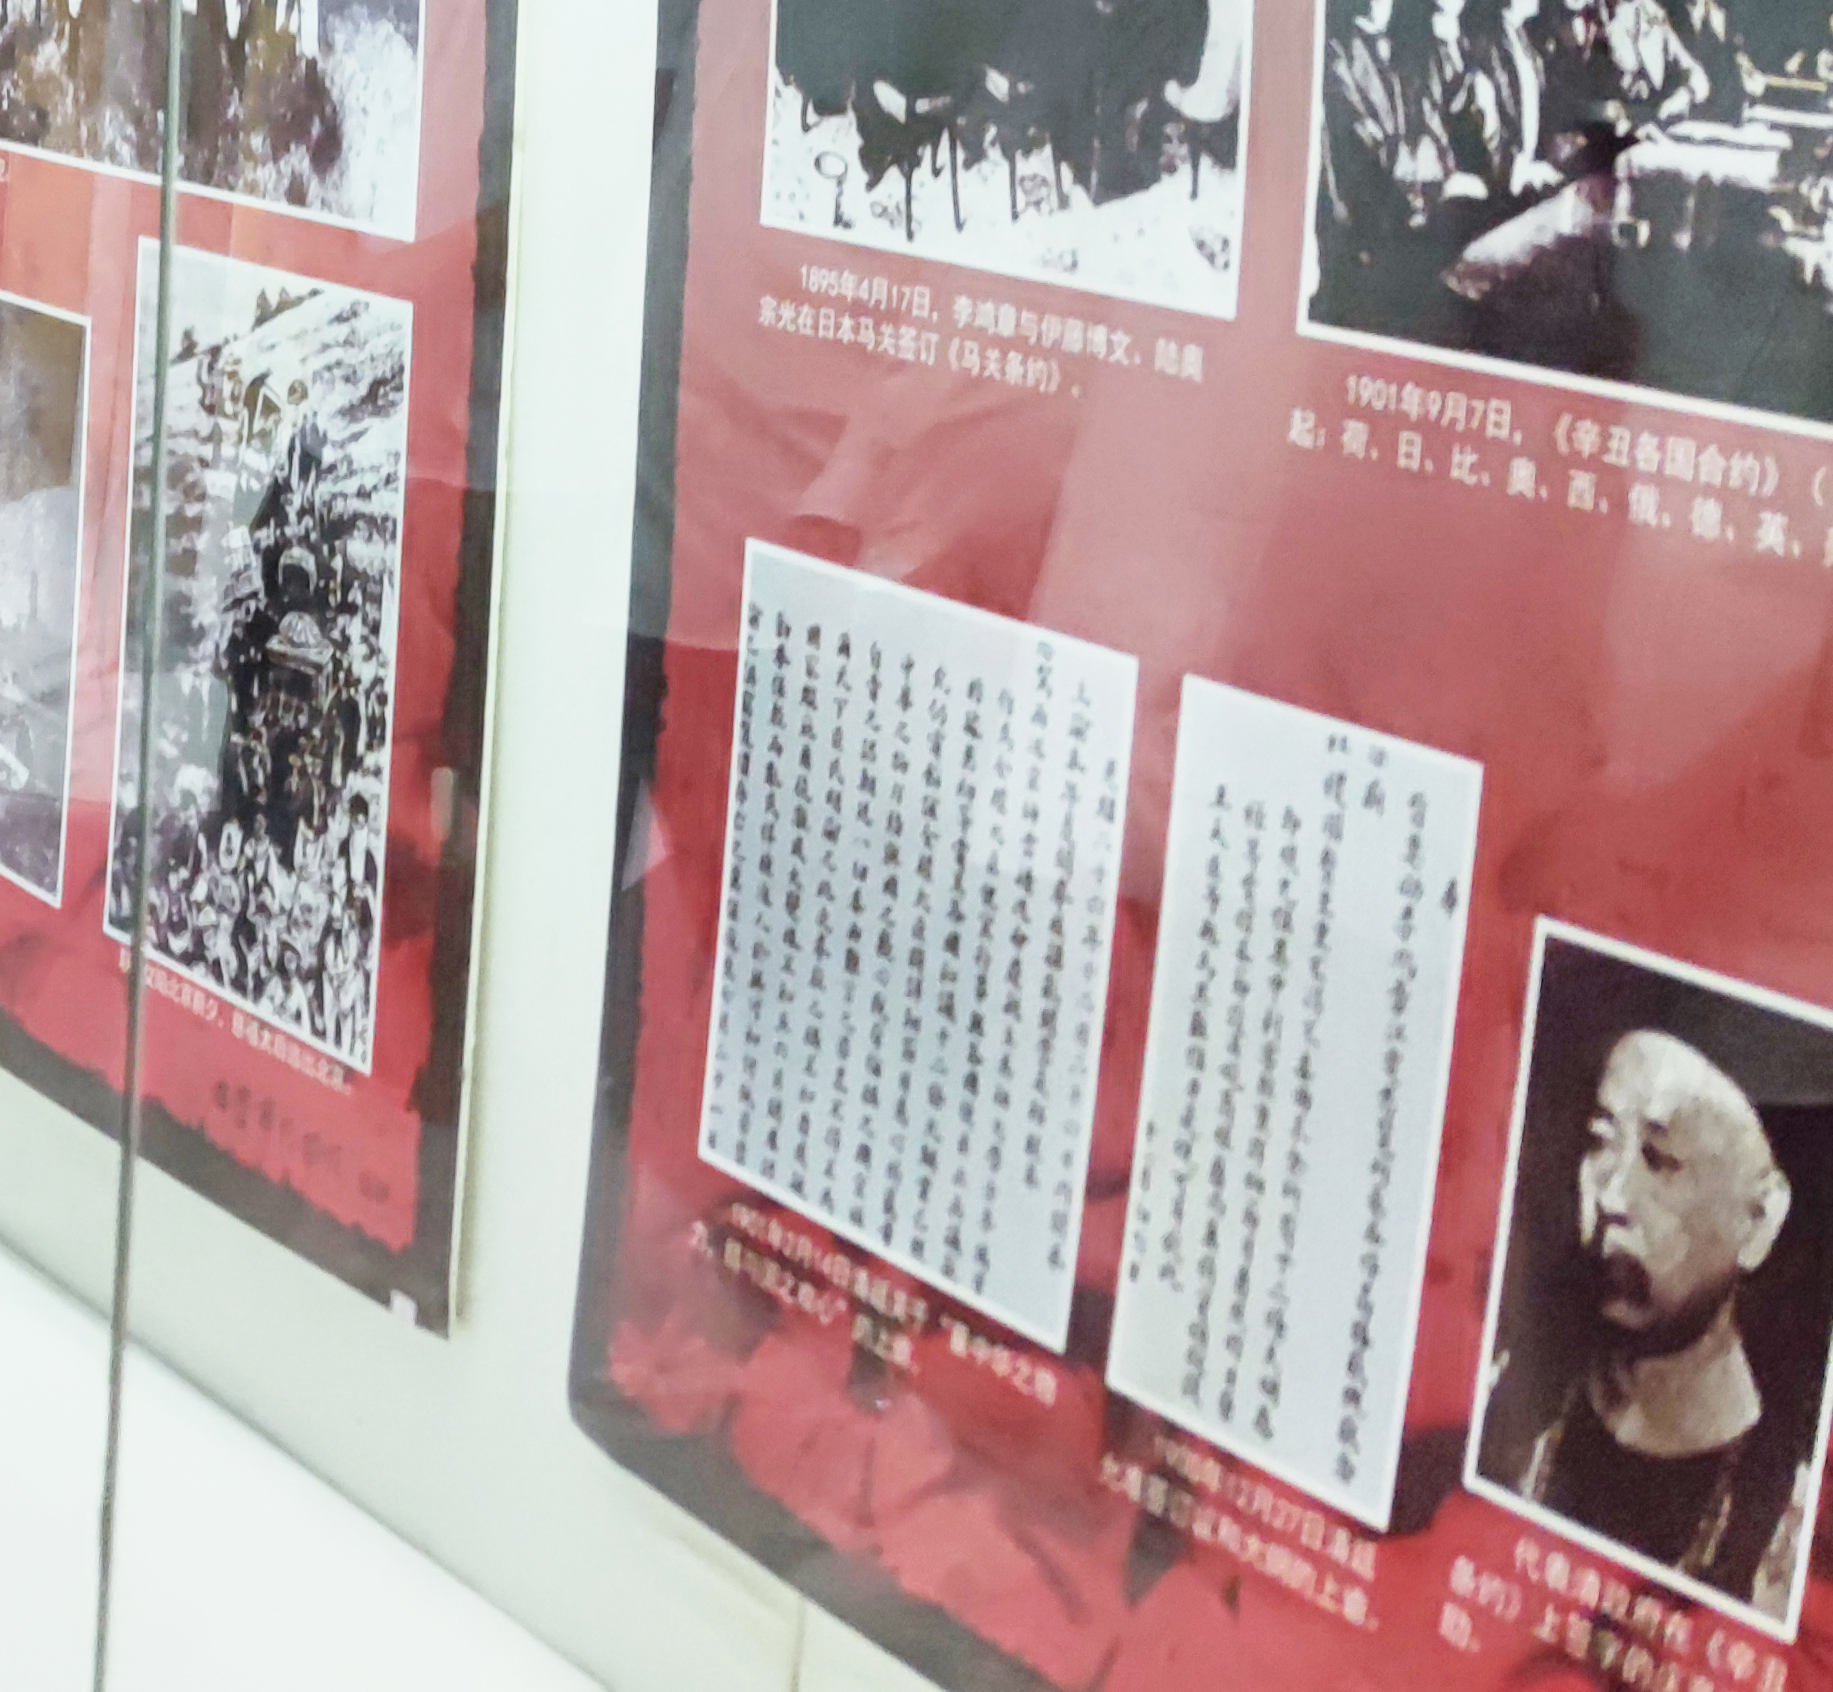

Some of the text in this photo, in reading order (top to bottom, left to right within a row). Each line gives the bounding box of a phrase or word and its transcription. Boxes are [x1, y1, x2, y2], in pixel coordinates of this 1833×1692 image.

[1286, 408, 1833, 568] 起：荷、日、比、奥、西、俄、德、英、
